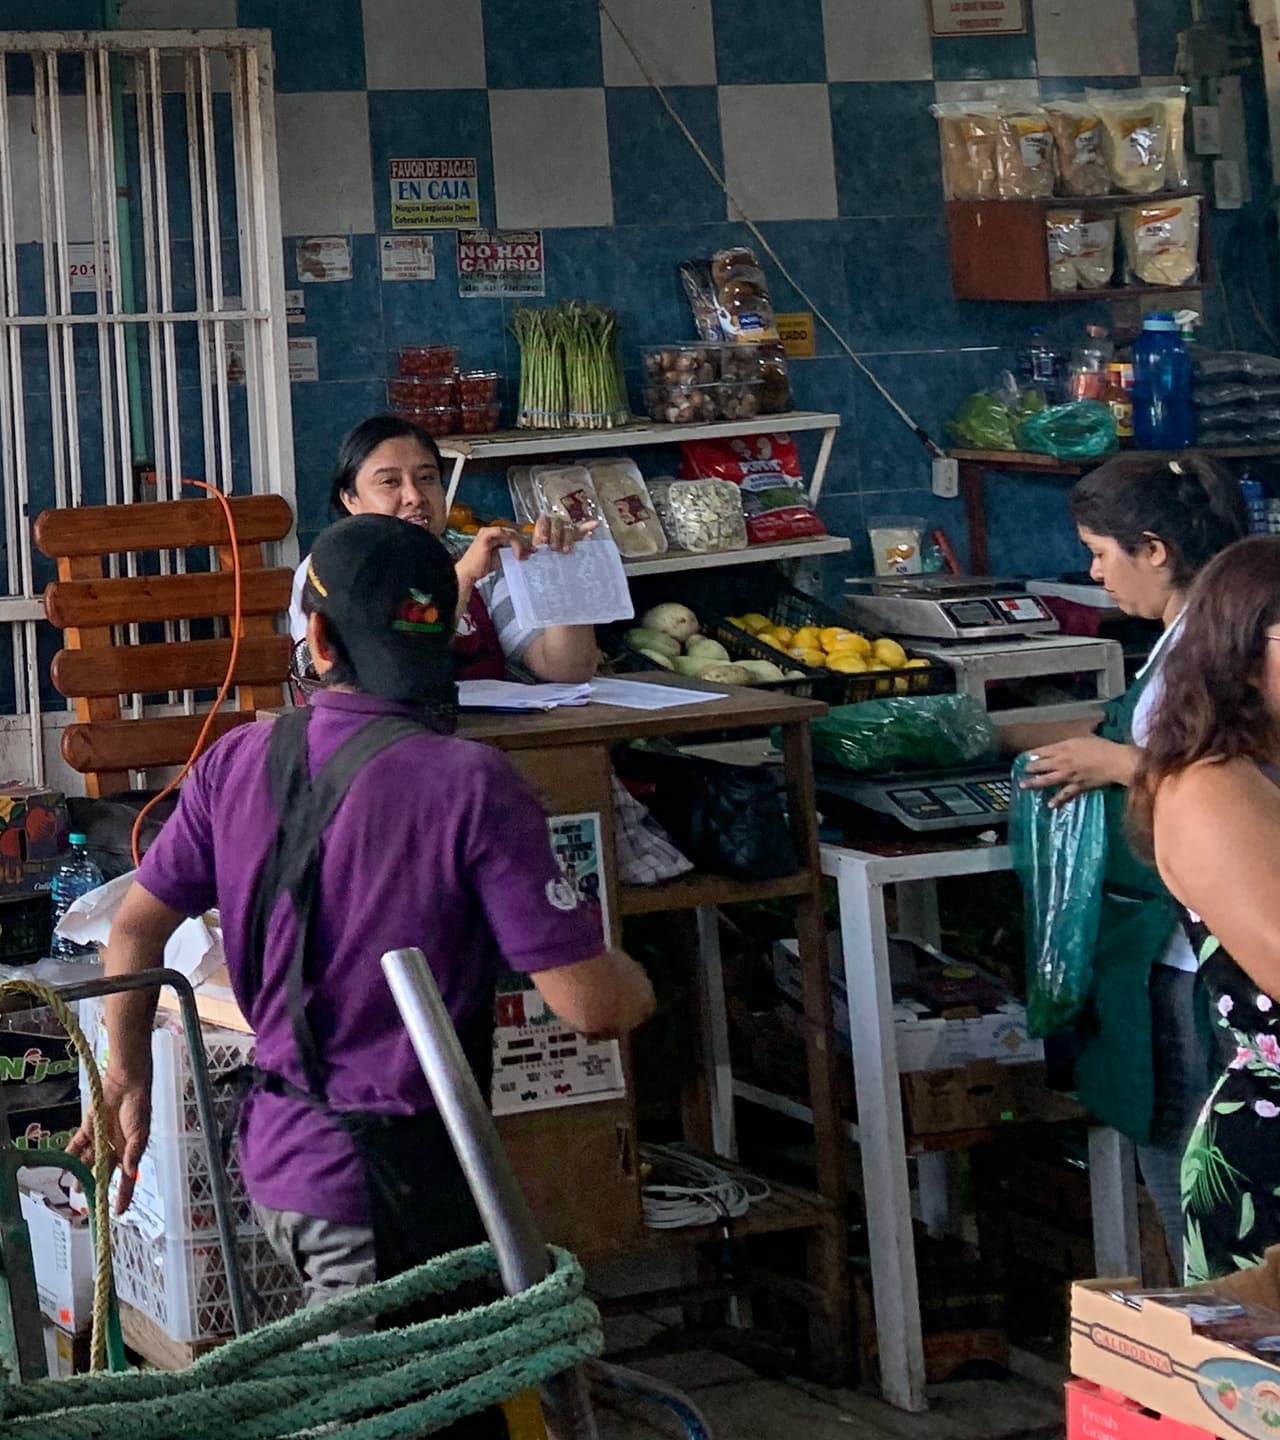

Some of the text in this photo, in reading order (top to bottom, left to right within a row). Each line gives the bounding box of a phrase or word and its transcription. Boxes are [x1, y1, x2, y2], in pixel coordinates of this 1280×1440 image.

[391, 160, 475, 178] FAVOR DE PAGAR
[398, 180, 472, 201] EN CAJA
[460, 244, 539, 259] NO HAY
[461, 258, 540, 272] CAMBIO
[1092, 1330, 1171, 1373] CALIFORNIA
